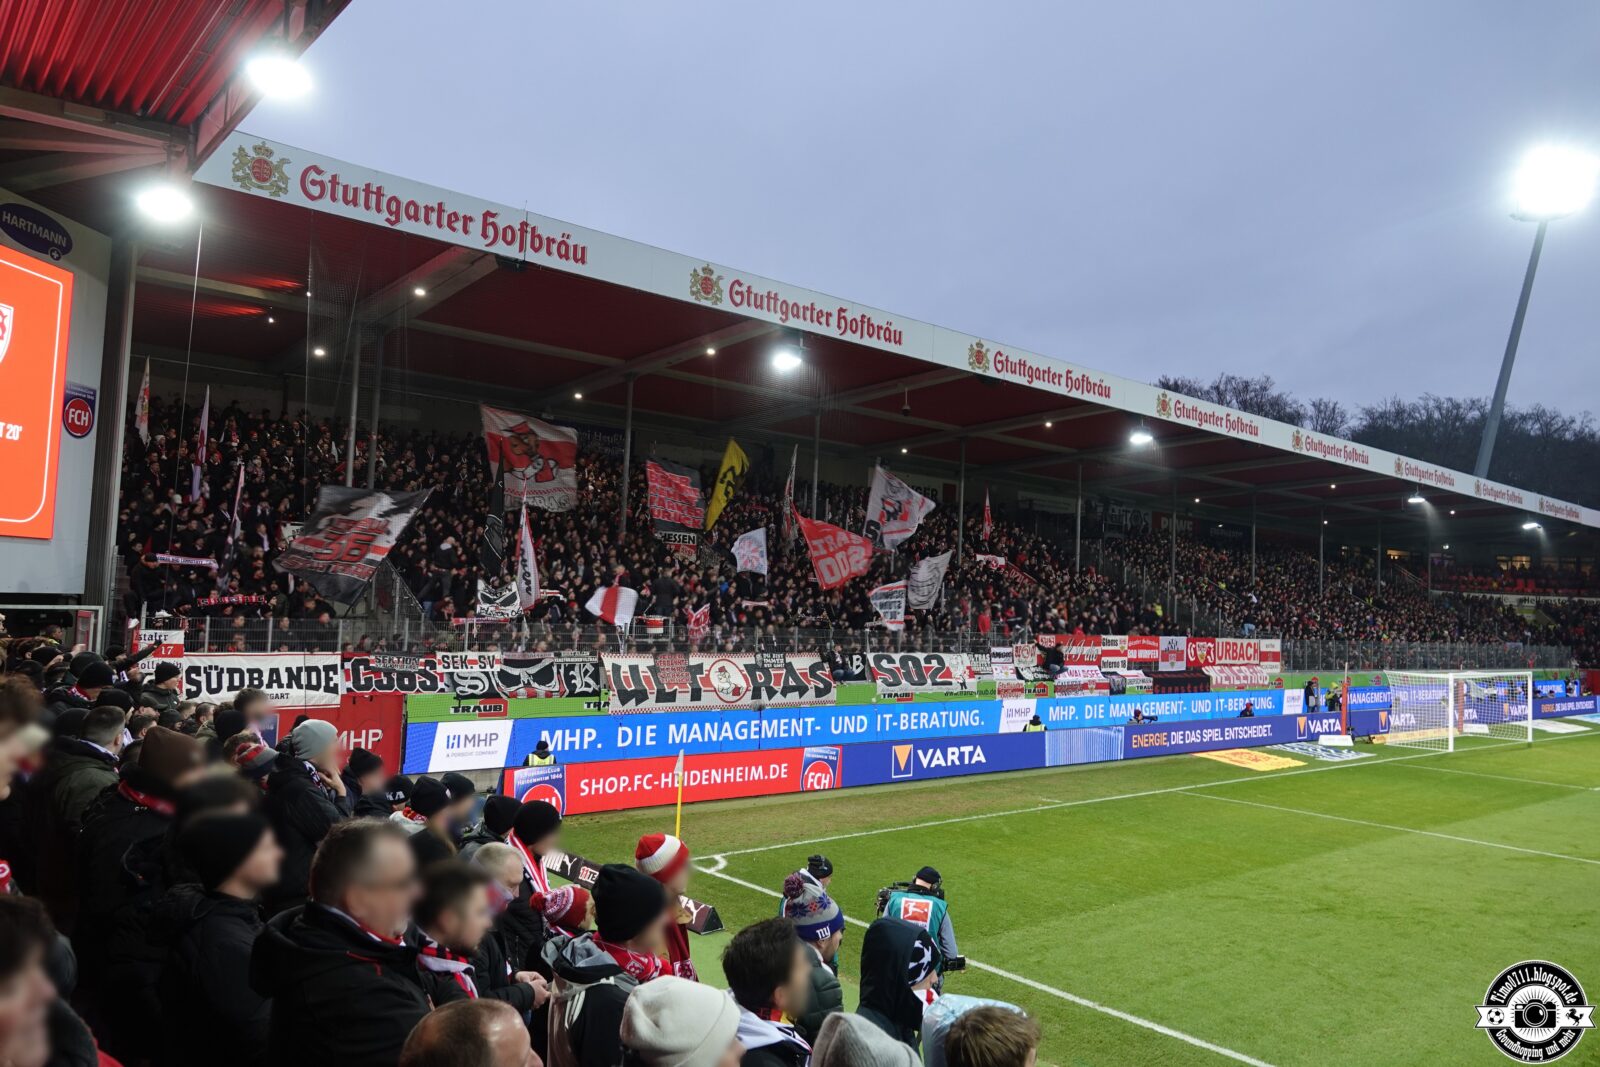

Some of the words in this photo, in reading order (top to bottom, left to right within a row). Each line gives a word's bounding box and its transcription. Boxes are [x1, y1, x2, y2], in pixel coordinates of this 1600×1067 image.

[300, 164, 474, 236] Stuttgarter
[481, 210, 588, 265] Hofbräu
[2, 211, 67, 247] HARTMANN
[729, 279, 832, 327] Stuttgarter
[837, 307, 903, 346] Hofbräu
[994, 351, 1062, 386] Stuttgarter
[1065, 369, 1111, 399] Hofbräu
[68, 408, 89, 427] FCH
[1174, 400, 1223, 428] Stuttgarter
[1225, 413, 1259, 437] Hofbräu
[1305, 436, 1342, 458] Stuttgarter
[1344, 445, 1369, 464] Hofbräu
[1405, 462, 1433, 482] Stuttgarter
[661, 532, 696, 544] HESSEN
[161, 646, 174, 655] 17
[375, 655, 420, 665] SEKTION
[1217, 641, 1259, 661] URBACH
[442, 654, 474, 670] SEK.
[478, 654, 496, 669] SV
[185, 664, 339, 700] SÜDBANDE
[451, 704, 503, 713] TRAUB
[1014, 707, 1031, 718] MHP
[1049, 705, 1078, 721] MHP.
[1085, 703, 1105, 720] DIE
[1191, 699, 1211, 714] UND
[1454, 708, 1477, 720] VRTA
[1510, 705, 1528, 716] VARTA
[1308, 718, 1342, 734] VARTA
[1388, 713, 1416, 726] VARTA
[541, 728, 602, 751] MHP.
[617, 725, 657, 747] DIE
[668, 716, 821, 745] MANAGEMENT-
[830, 714, 868, 734] UND
[877, 709, 985, 732] IT-BERATUNG.
[1132, 731, 1170, 749] ENERGIE,
[1170, 730, 1184, 745] DIE
[1185, 729, 1201, 743] DAS
[1202, 727, 1223, 742] SPIEL
[1224, 724, 1272, 741] ENTSCHEIDET.
[464, 733, 499, 748] MHP
[917, 745, 986, 769] VARTA
[580, 763, 788, 797] SHOP.FC-HEIDENHEIM.DE
[807, 771, 830, 790] FCH
